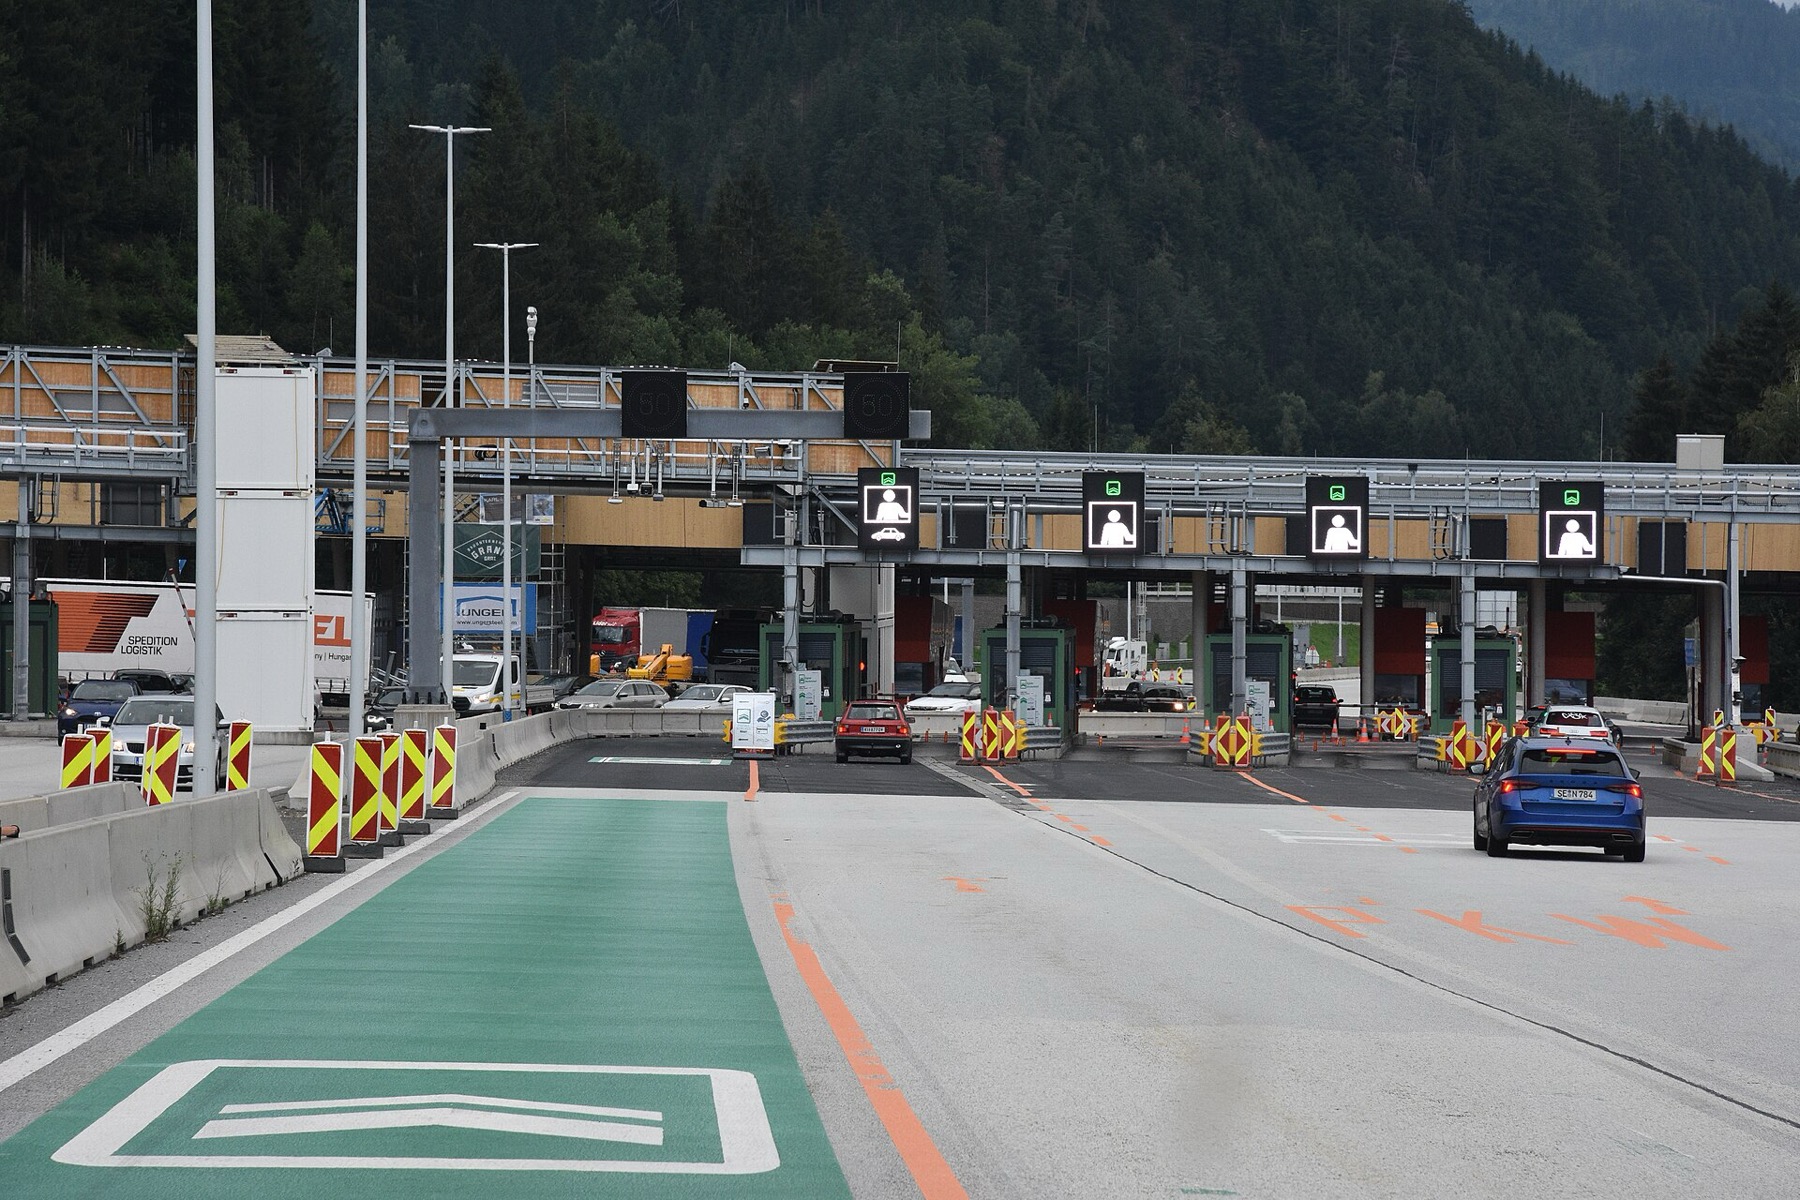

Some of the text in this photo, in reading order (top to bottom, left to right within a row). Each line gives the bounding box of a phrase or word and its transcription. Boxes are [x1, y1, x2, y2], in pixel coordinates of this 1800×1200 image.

[461, 608, 504, 617] UNGE
[128, 635, 178, 646] SPEDITION
[120, 645, 163, 656] LOGISTIK
[1578, 790, 1594, 799] 784
